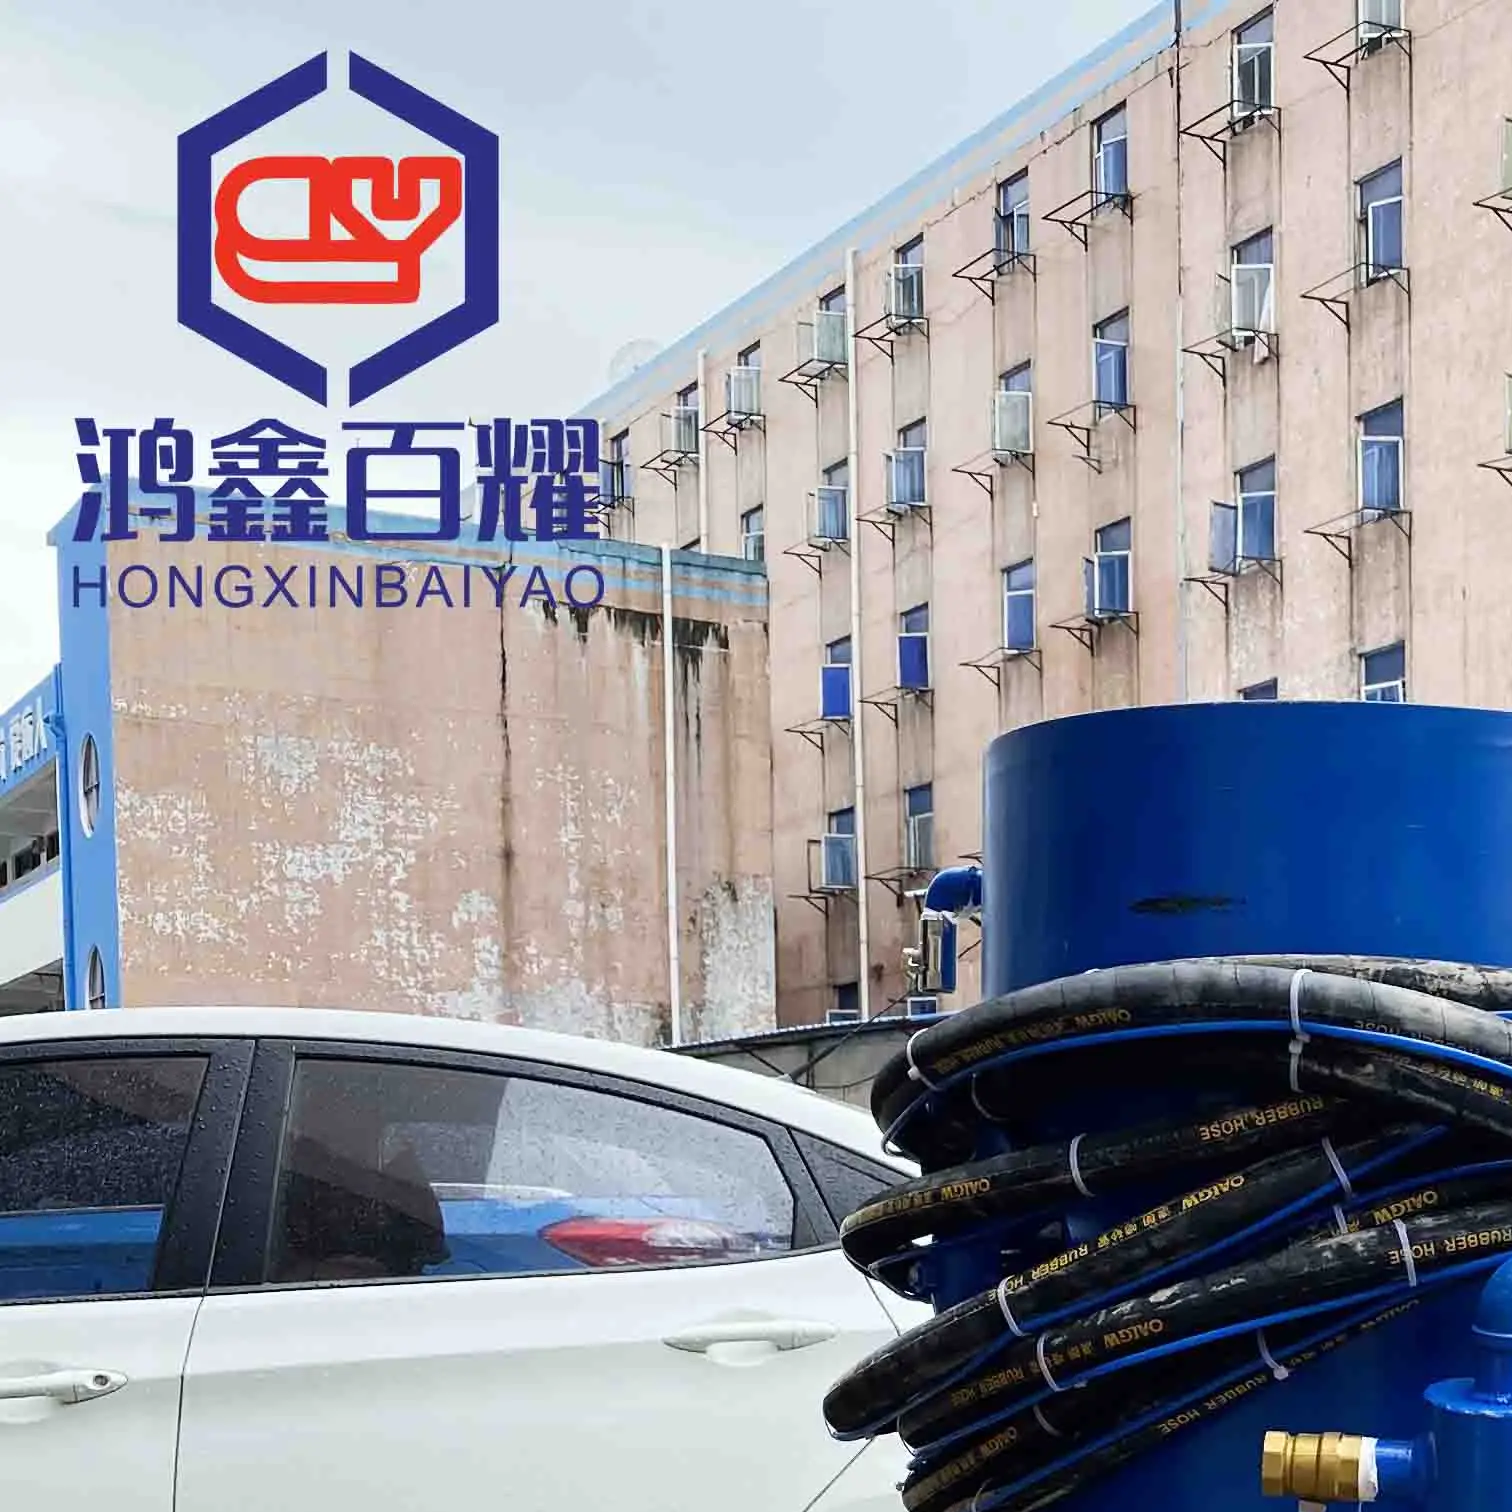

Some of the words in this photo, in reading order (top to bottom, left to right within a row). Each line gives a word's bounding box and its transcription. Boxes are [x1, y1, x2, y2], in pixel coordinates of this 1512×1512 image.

[1254, 1095, 1324, 1128] RUBBER
[1200, 1112, 1246, 1141] HOSE
[1031, 1243, 1089, 1281] RUBBER
[1387, 1242, 1437, 1266] HOE
[987, 1276, 1024, 1303] HOE
[1158, 1407, 1201, 1435] HOSE
